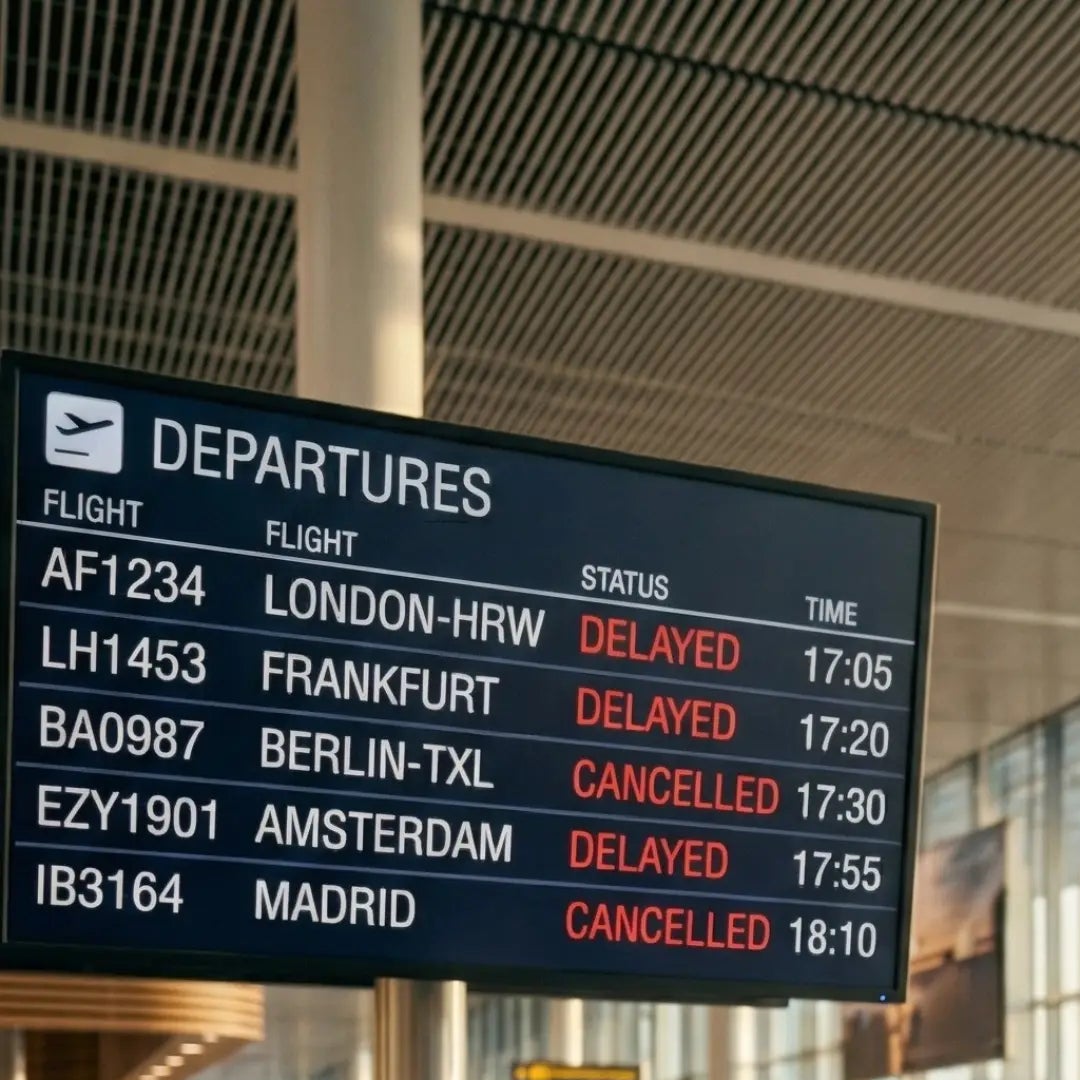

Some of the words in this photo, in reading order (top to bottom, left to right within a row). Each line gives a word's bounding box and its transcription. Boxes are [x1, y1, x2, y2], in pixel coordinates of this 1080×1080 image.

[153, 417, 491, 518] DEPARTURES
[44, 488, 144, 528] FLIGHT
[266, 519, 359, 558] FLIGHT
[581, 564, 669, 601] STATUS
[805, 595, 858, 627] TIME
[41, 546, 206, 606] AF1234
[265, 574, 546, 648] LONDON-HRW
[580, 615, 740, 671] DELAYED
[804, 646, 893, 692] 17:05
[42, 625, 206, 684] LH1453
[262, 650, 500, 715] FRANKFURT
[576, 687, 736, 741] DELAYED
[800, 713, 890, 758] 17:20
[40, 704, 205, 760] BA0987
[261, 727, 495, 789] BERLIN-TXL
[573, 759, 779, 815] CANCELLED
[797, 782, 886, 826] 17:30
[38, 784, 217, 840] EZY1901
[254, 803, 513, 863] AMSTERDAM
[570, 830, 729, 879] DELAYED
[793, 849, 881, 892] 17:55
[37, 864, 184, 914] IB3164
[255, 879, 416, 928] MADRID
[566, 901, 770, 951] CANCELLED
[789, 916, 877, 958] 18:10
